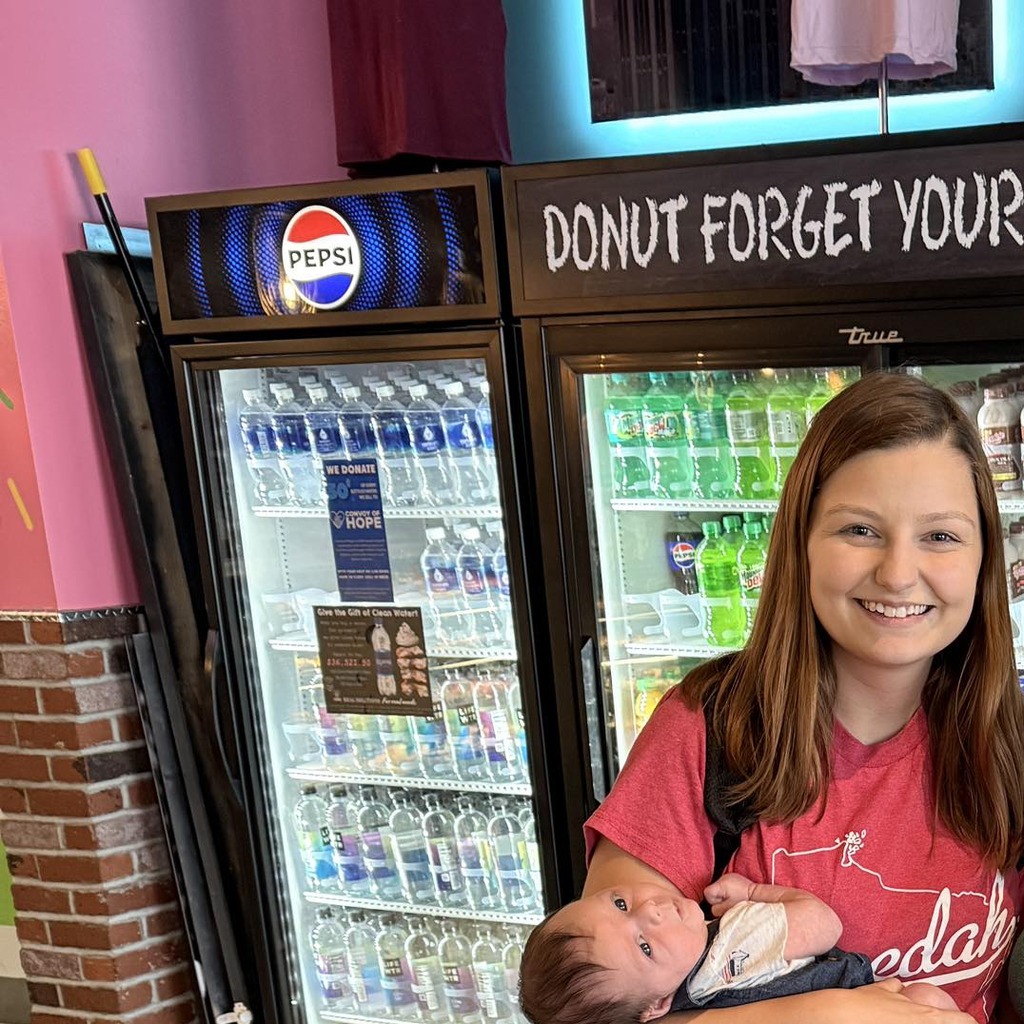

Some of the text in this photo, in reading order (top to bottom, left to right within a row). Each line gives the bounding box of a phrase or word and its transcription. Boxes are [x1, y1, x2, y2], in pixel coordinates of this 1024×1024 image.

[542, 194, 688, 273] DONUT
[700, 179, 881, 264] FORGET
[288, 246, 353, 269] PEPSI
[326, 464, 376, 475] WE DONATE
[346, 517, 382, 528] HOPE
[317, 608, 418, 618] Give the Gift of Clean Water!
